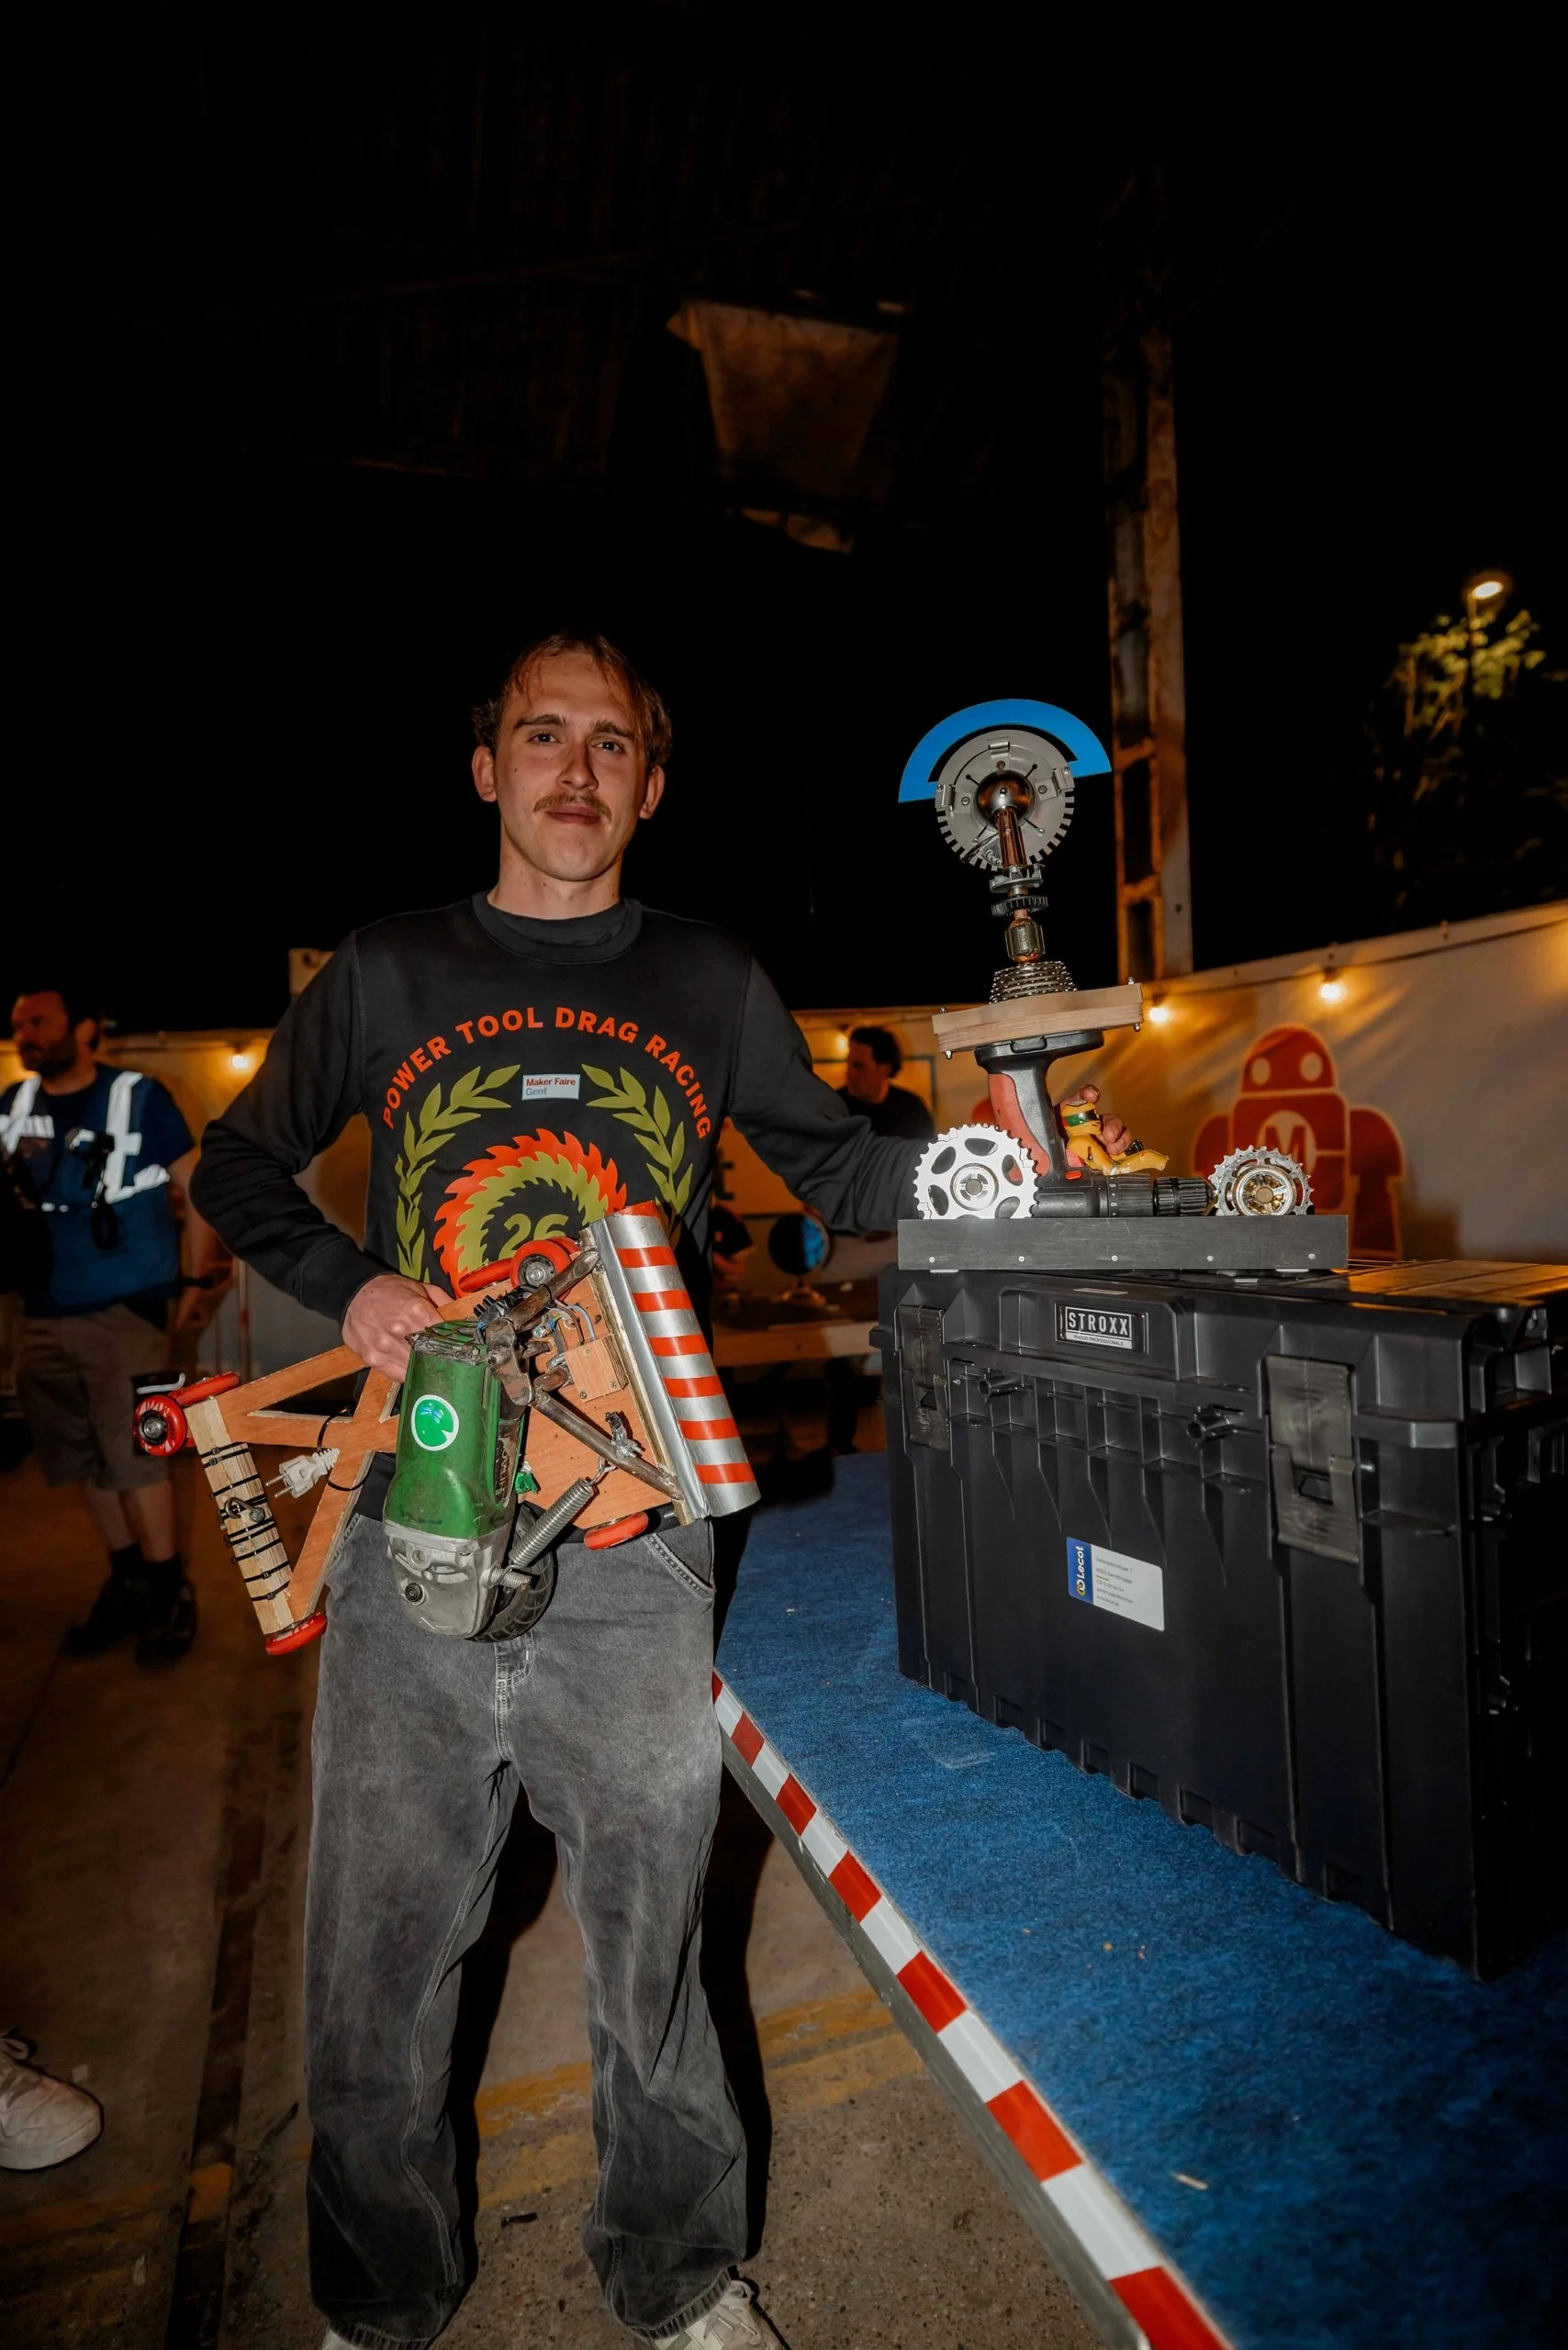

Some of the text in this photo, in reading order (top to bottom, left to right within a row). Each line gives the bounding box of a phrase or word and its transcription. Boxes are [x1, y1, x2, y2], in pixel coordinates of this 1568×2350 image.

[382, 1006, 712, 1139] POWER TOOL DRAG RACING
[526, 1077, 577, 1087] Maker Faire
[525, 1087, 548, 1096] Gent
[1069, 1312, 1128, 1336] STROXX
[1075, 1545, 1085, 1580] Lecot
